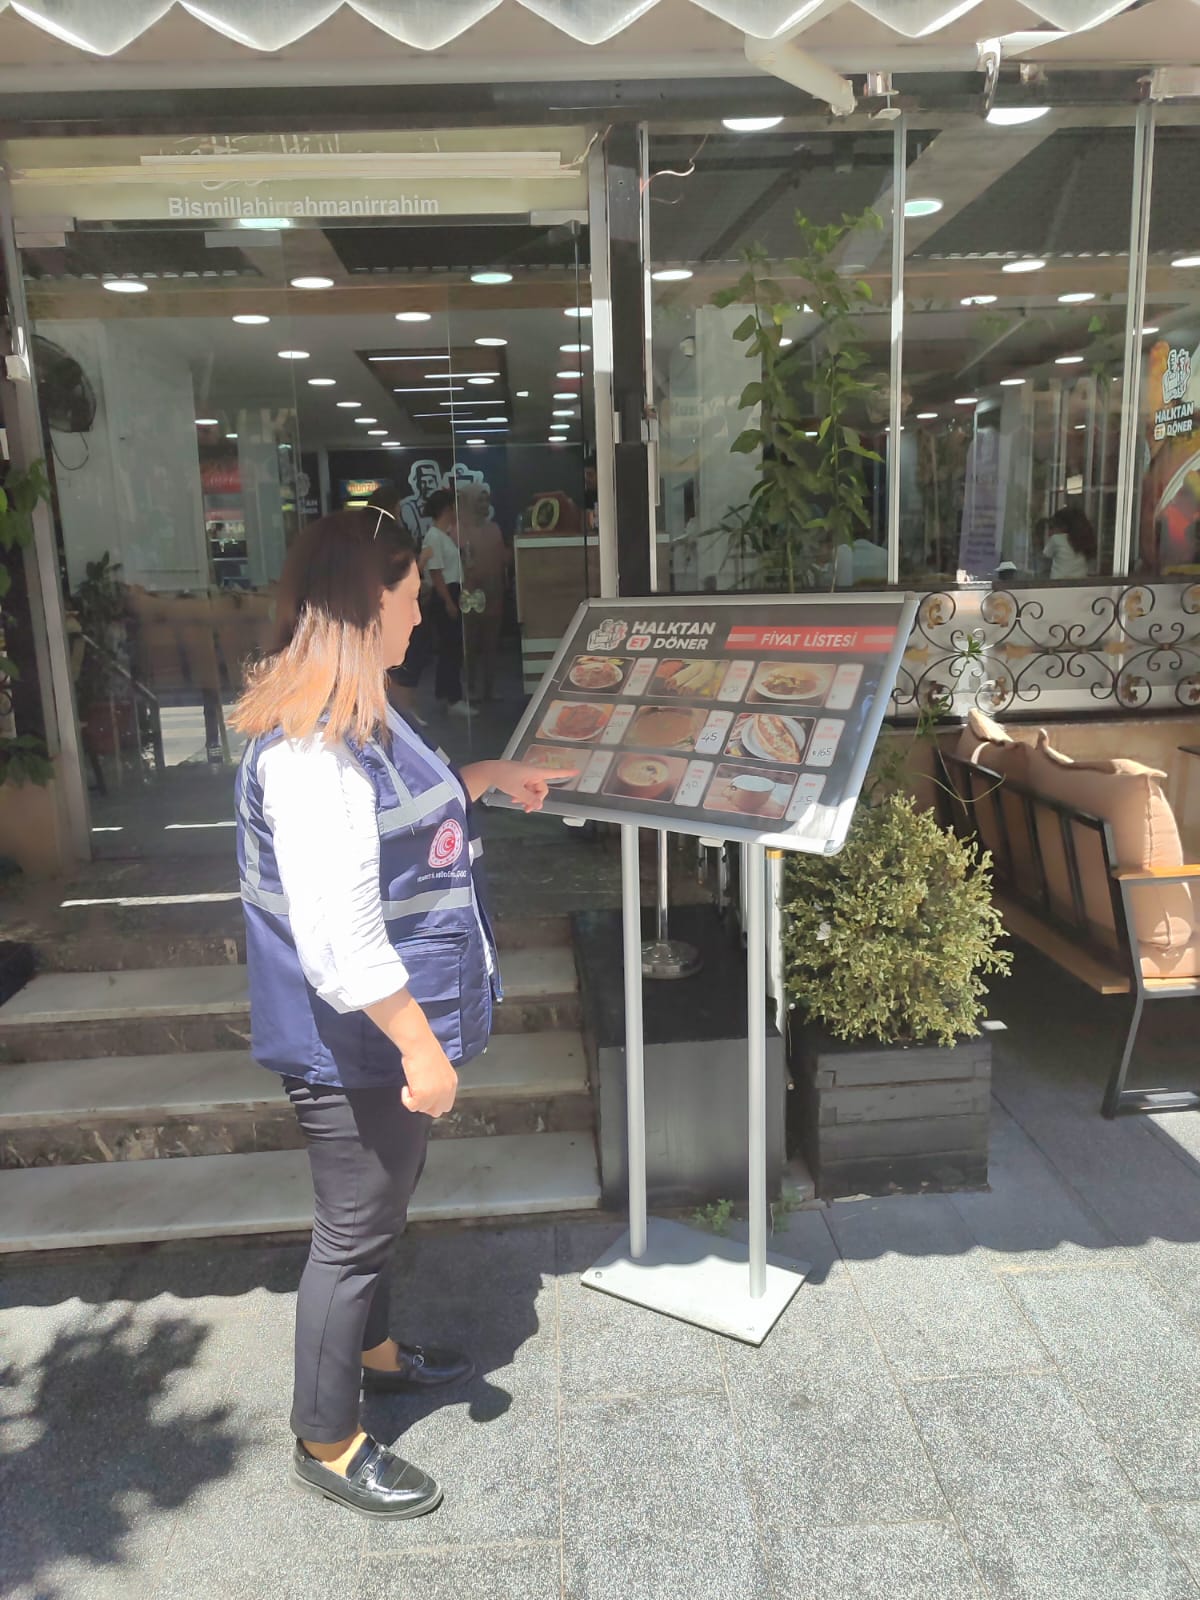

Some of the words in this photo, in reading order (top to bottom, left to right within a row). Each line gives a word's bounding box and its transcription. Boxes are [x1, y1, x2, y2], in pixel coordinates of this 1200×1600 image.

[168, 195, 440, 217] Bismillahirrahmanirrahim
[1155, 402, 1194, 424] HALKTAN
[1167, 419, 1193, 436] DÖNER
[631, 621, 717, 635] HALKTAN
[629, 637, 649, 648] ET
[653, 636, 708, 650] DÖNER
[760, 630, 801, 646] FİYAT
[803, 632, 858, 648] LİSTESİ
